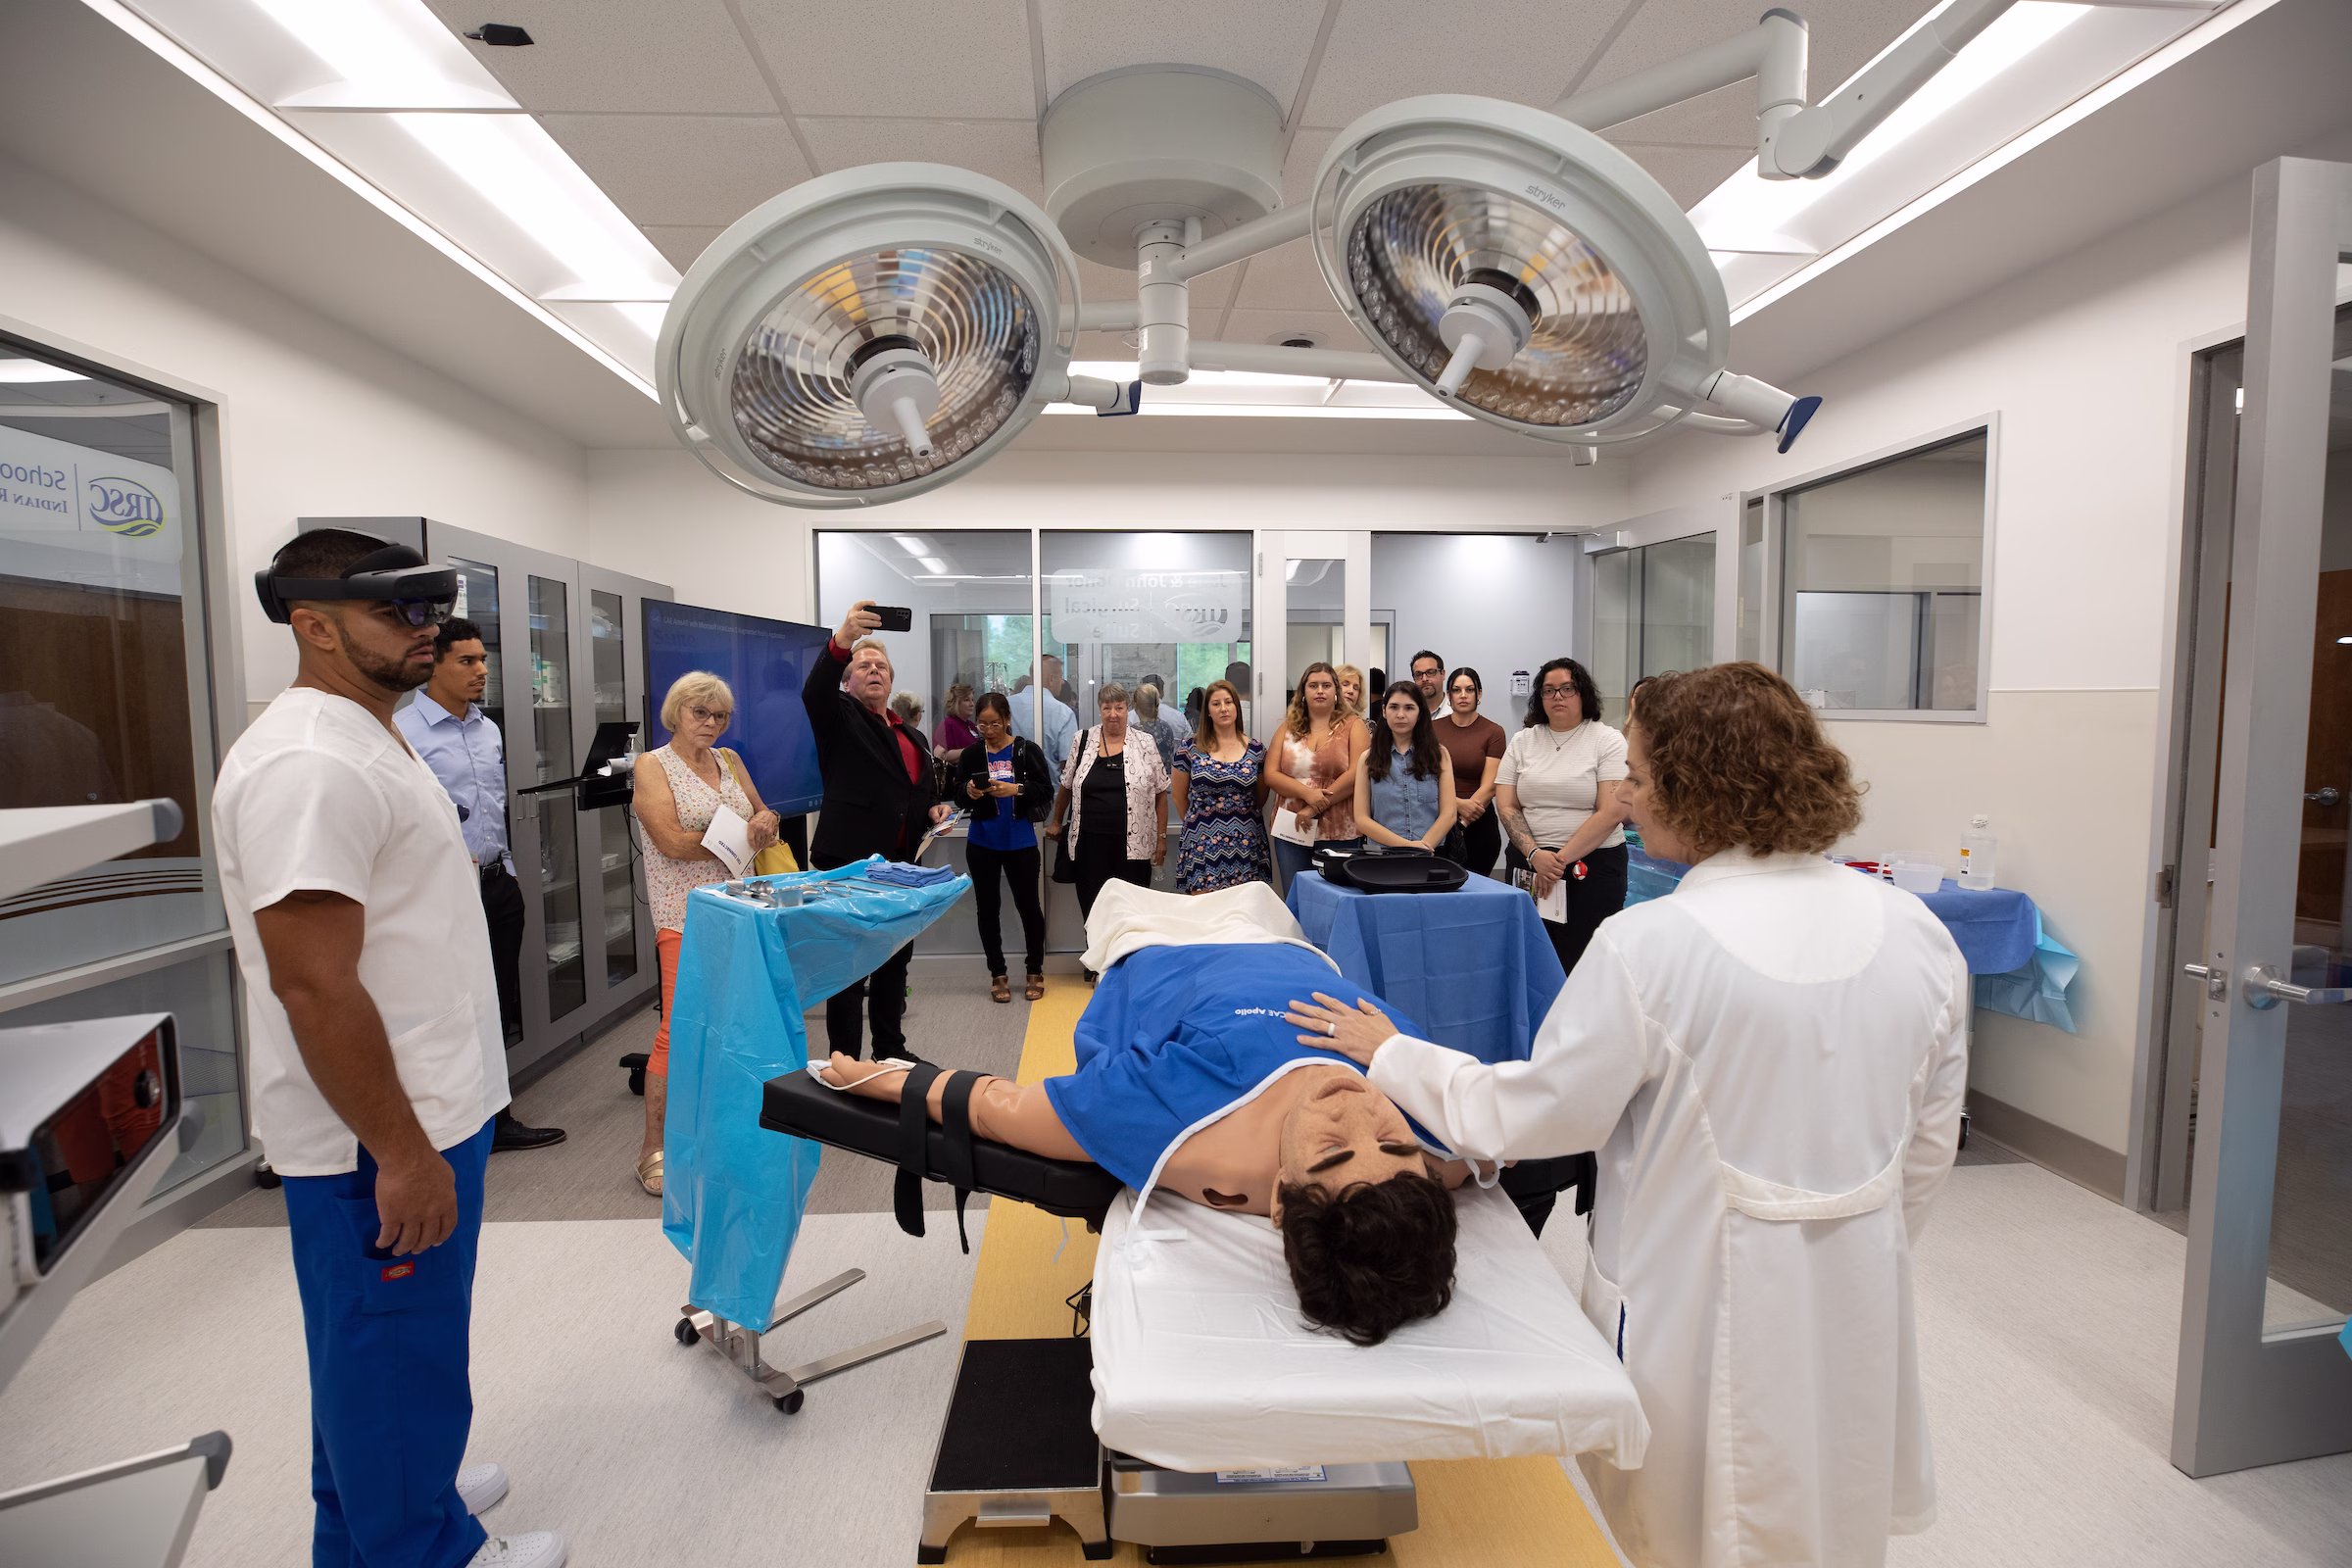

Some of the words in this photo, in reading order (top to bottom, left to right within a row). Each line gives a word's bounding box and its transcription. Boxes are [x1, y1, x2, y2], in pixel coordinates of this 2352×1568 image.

[1525, 185, 1566, 210] stryker
[973, 237, 1004, 255] stryker
[714, 348, 727, 381] stryker
[1235, 1007, 1266, 1016] Apollo
[1268, 1009, 1286, 1018] CAE
